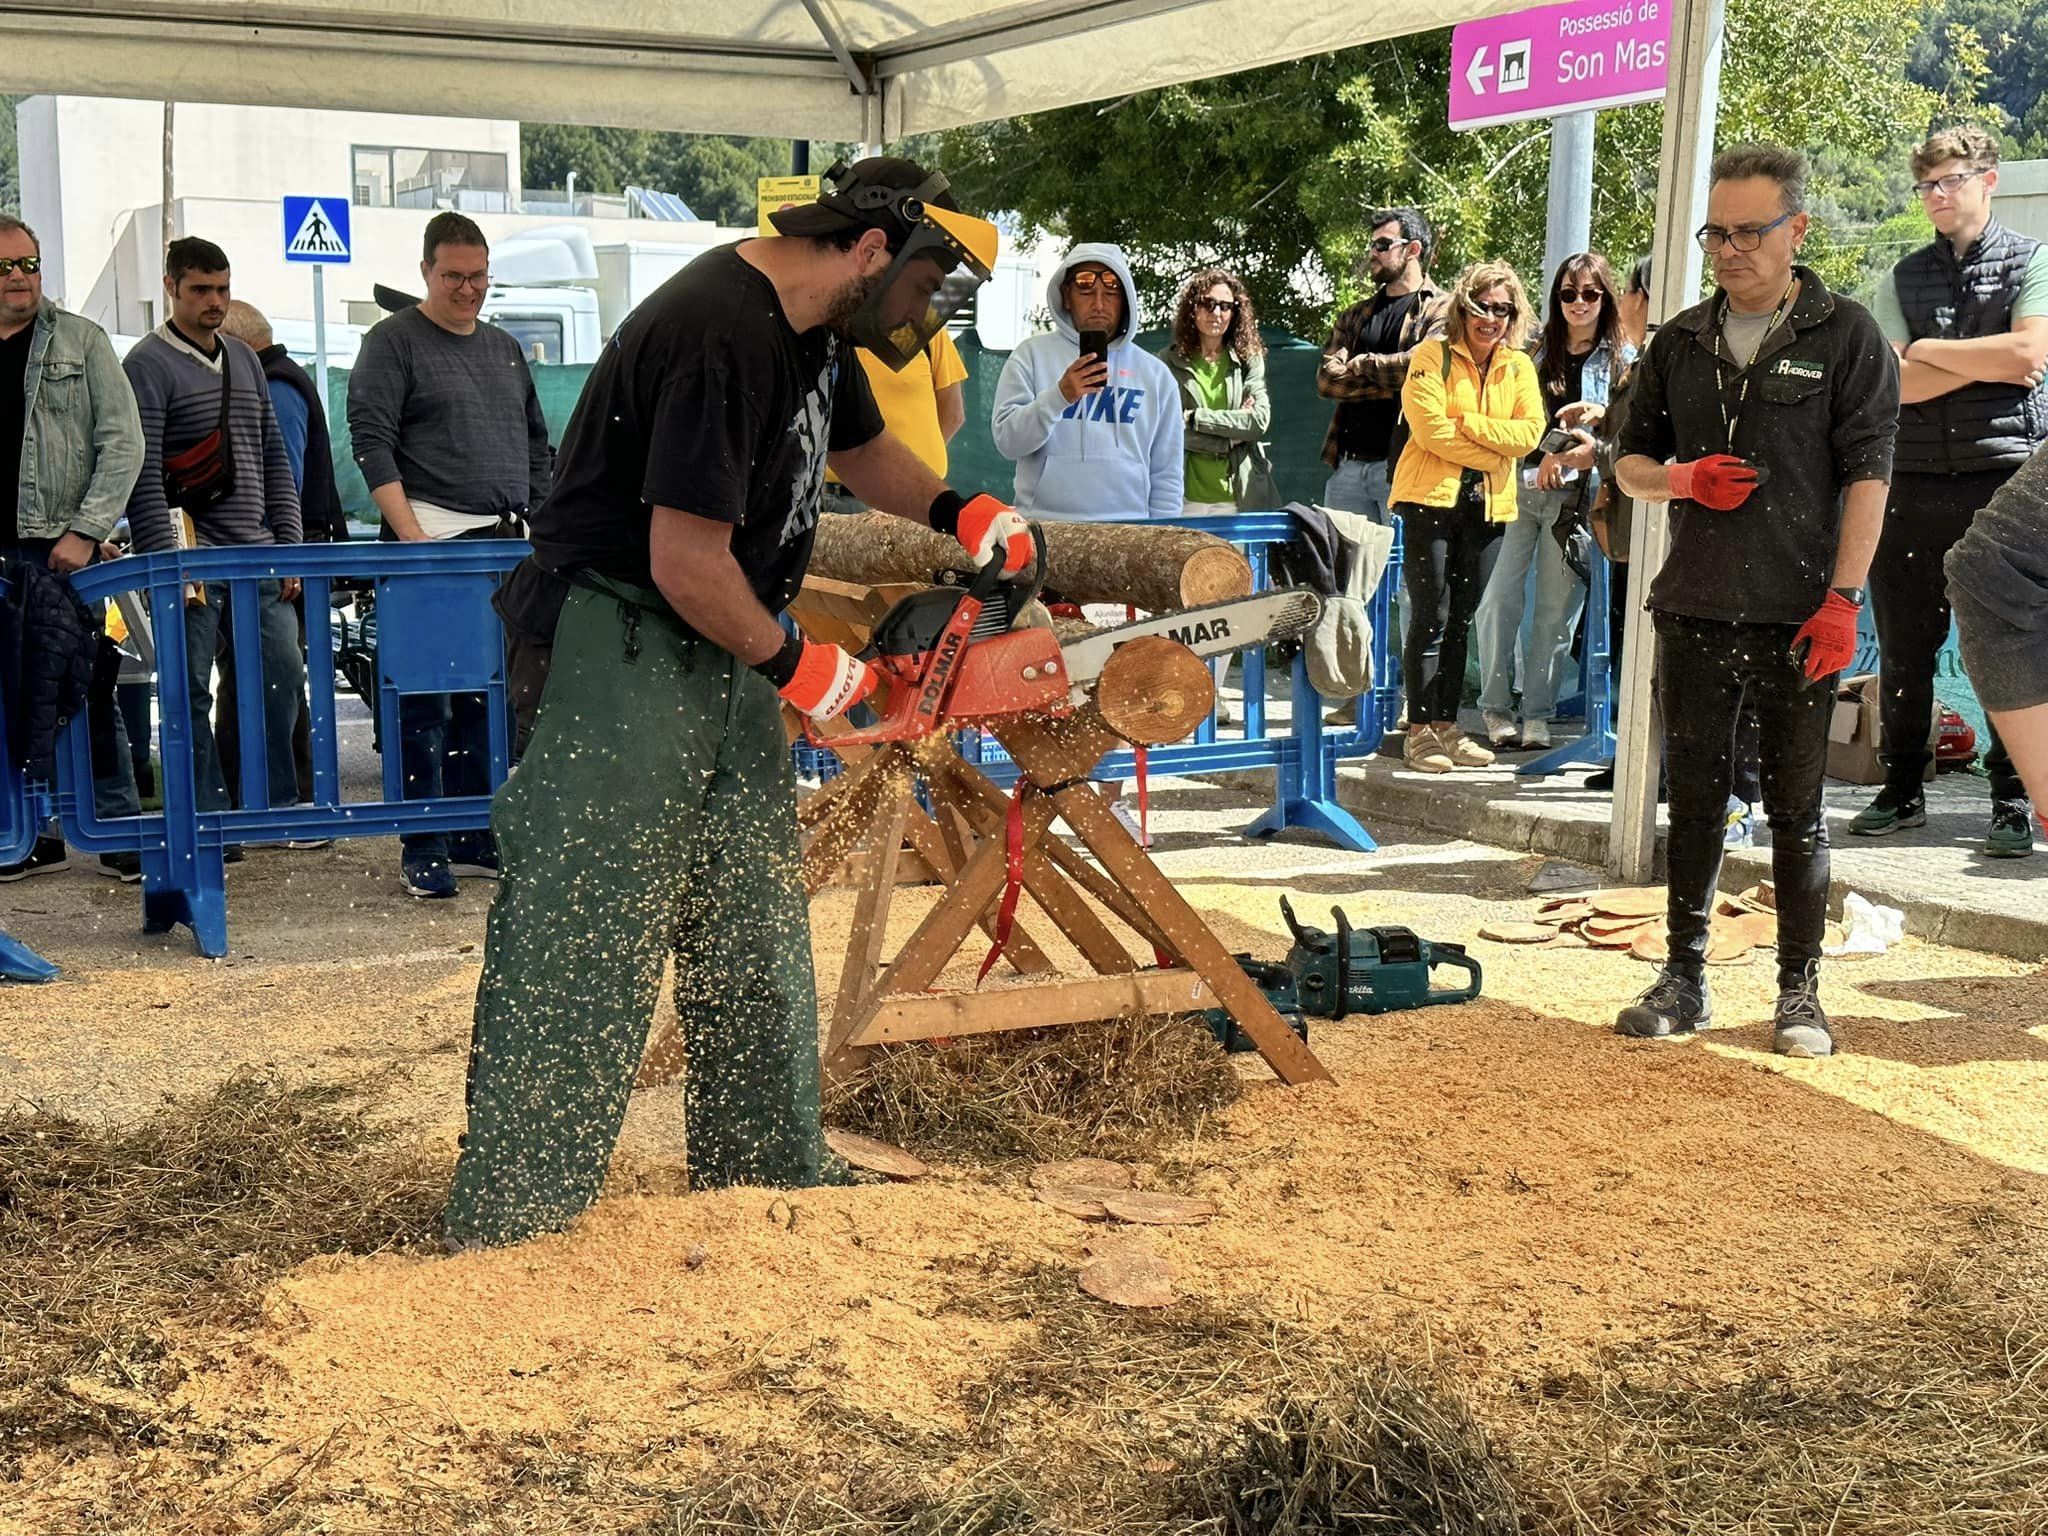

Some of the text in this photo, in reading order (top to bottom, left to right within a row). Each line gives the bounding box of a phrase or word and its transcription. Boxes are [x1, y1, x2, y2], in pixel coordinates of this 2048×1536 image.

[1560, 0, 1658, 38] Possessió de
[1557, 38, 1665, 83] Son Mas
[918, 633, 961, 717] DOLMAR
